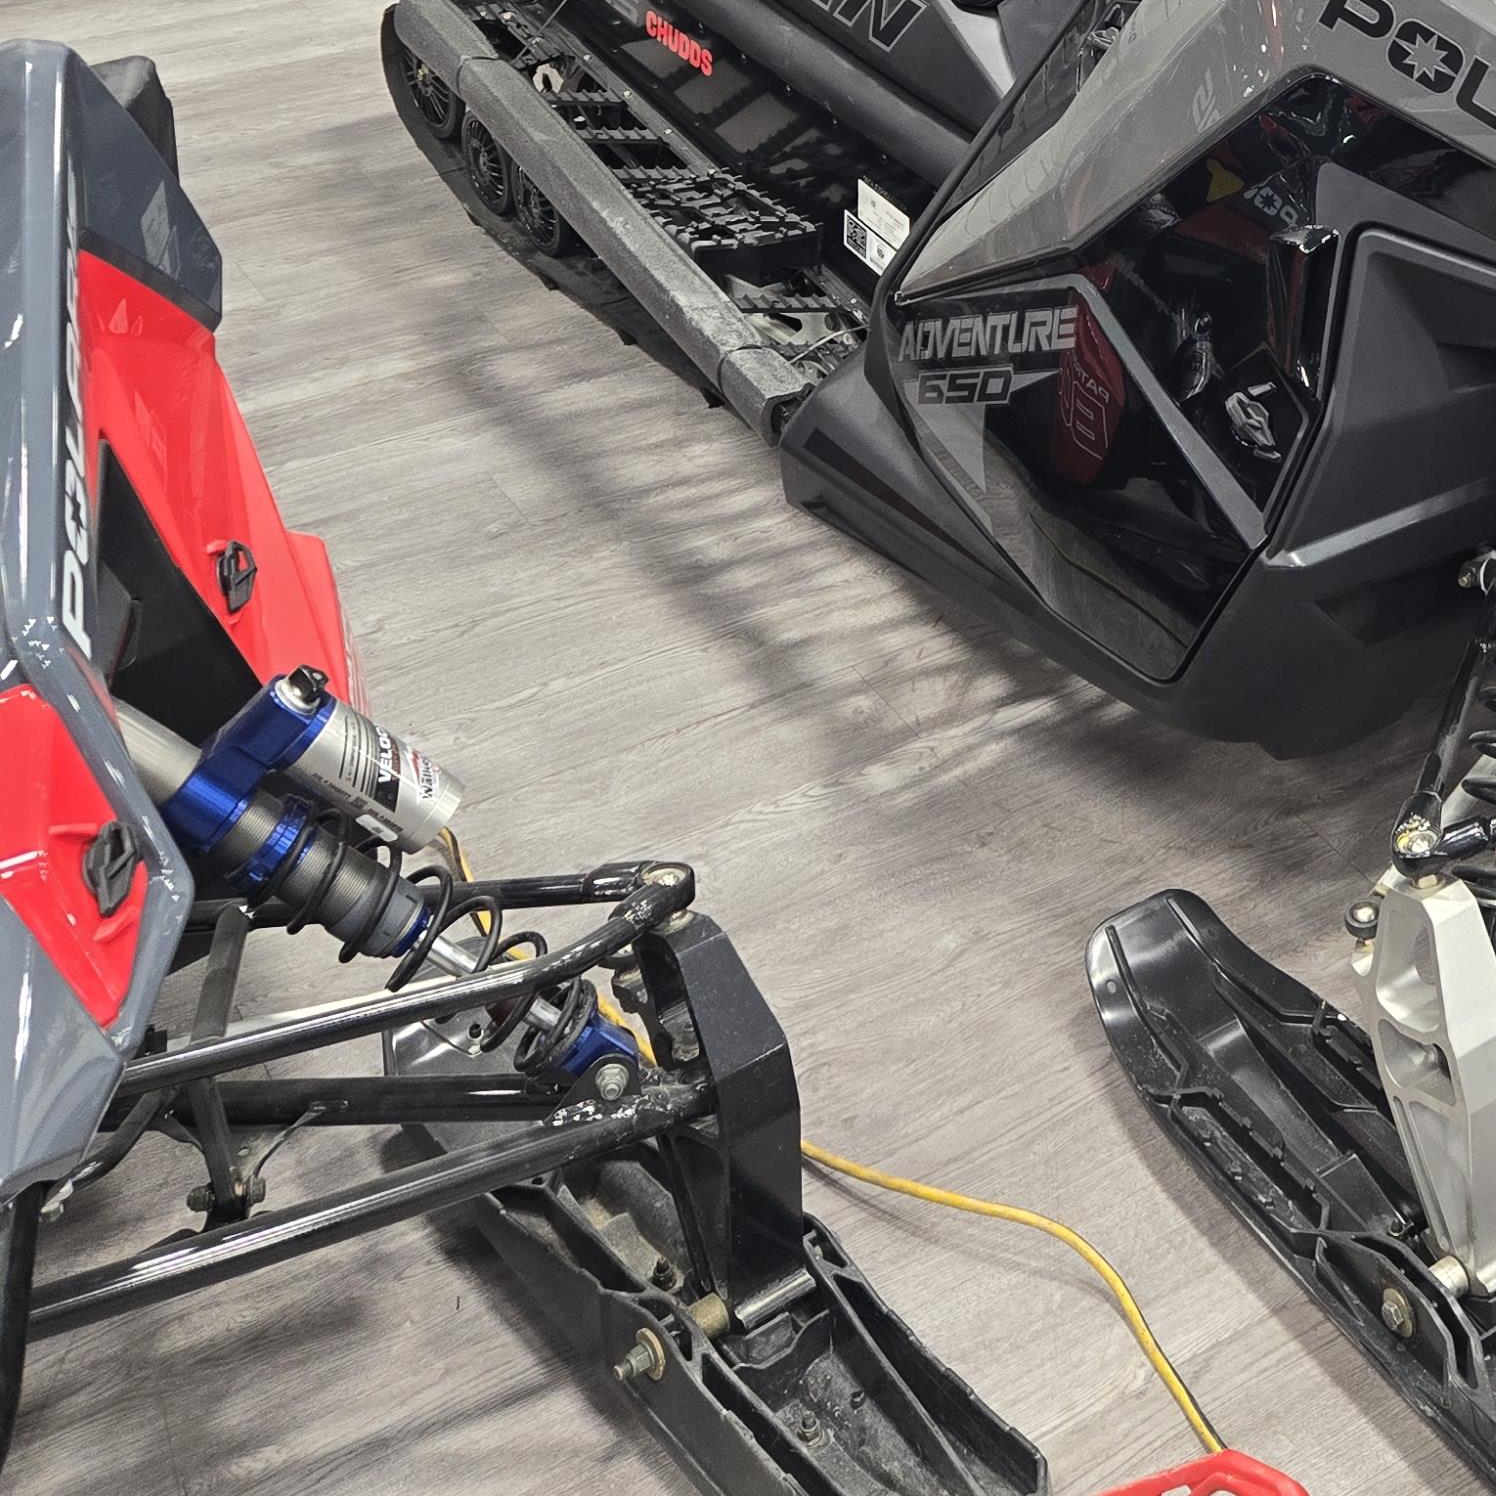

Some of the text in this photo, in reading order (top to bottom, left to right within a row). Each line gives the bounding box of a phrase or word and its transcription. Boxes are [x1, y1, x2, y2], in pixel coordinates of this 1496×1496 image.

[645, 10, 713, 77] CHUDDS
[898, 304, 1079, 362] ADVENTURE
[918, 363, 1014, 405] 650
